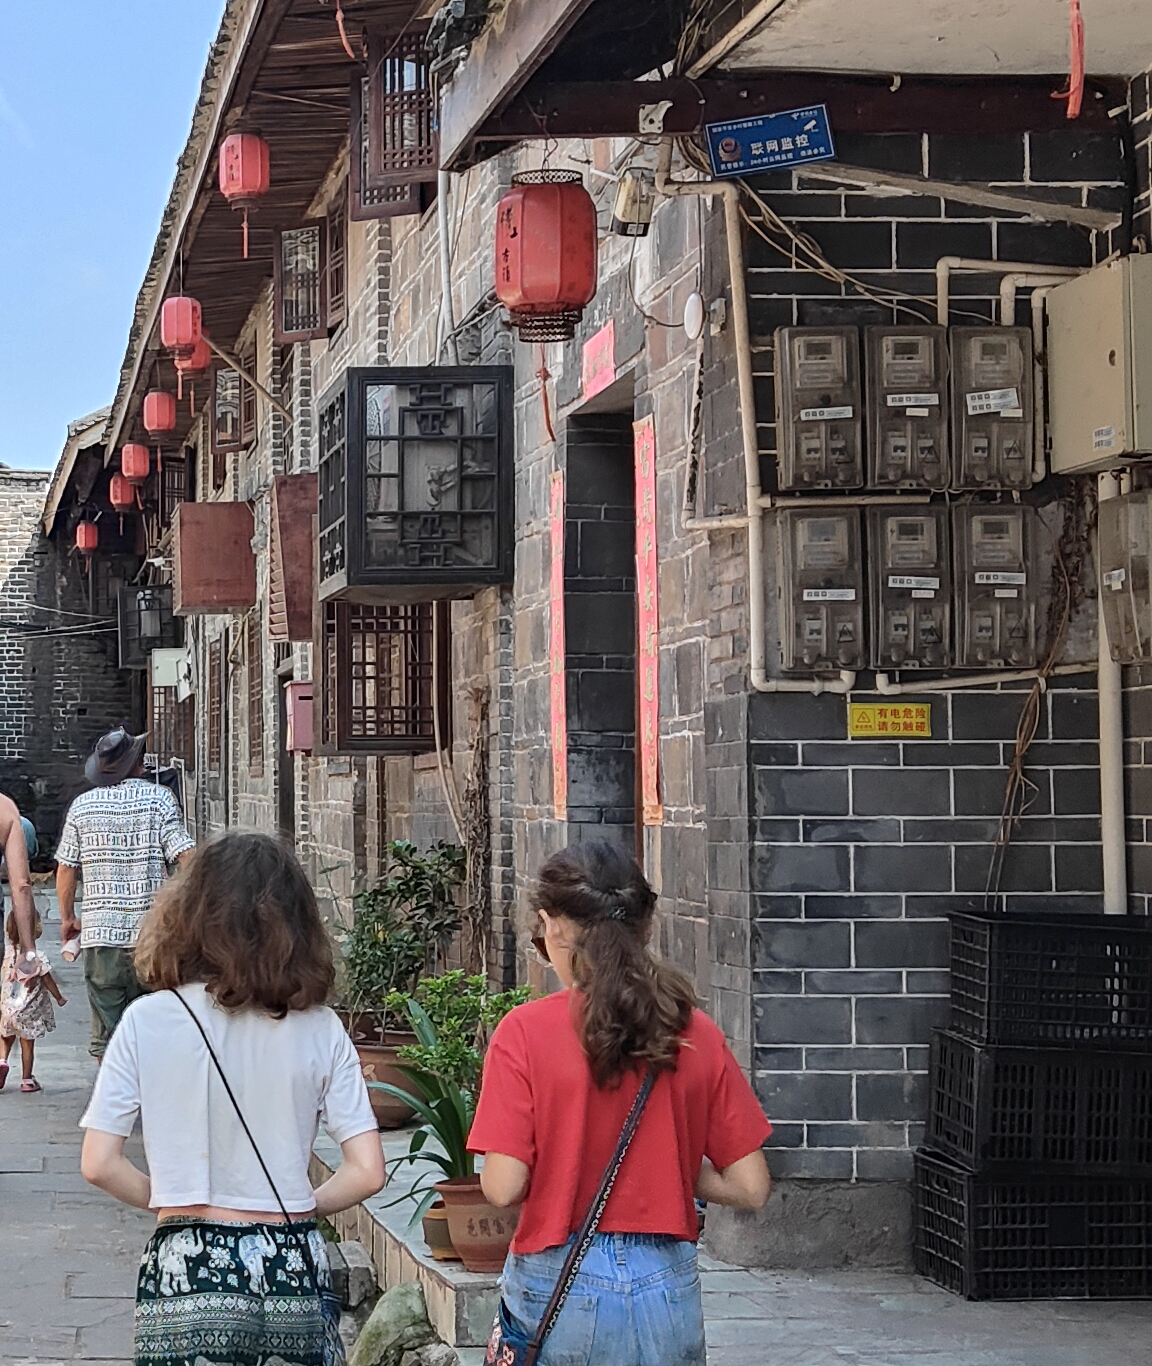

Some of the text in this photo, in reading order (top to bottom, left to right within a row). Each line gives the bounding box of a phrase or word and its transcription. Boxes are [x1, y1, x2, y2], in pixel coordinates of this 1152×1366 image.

[750, 133, 810, 156] 联网监控
[877, 707, 927, 719] 有电危险
[877, 721, 927, 732] 请勿触碰
